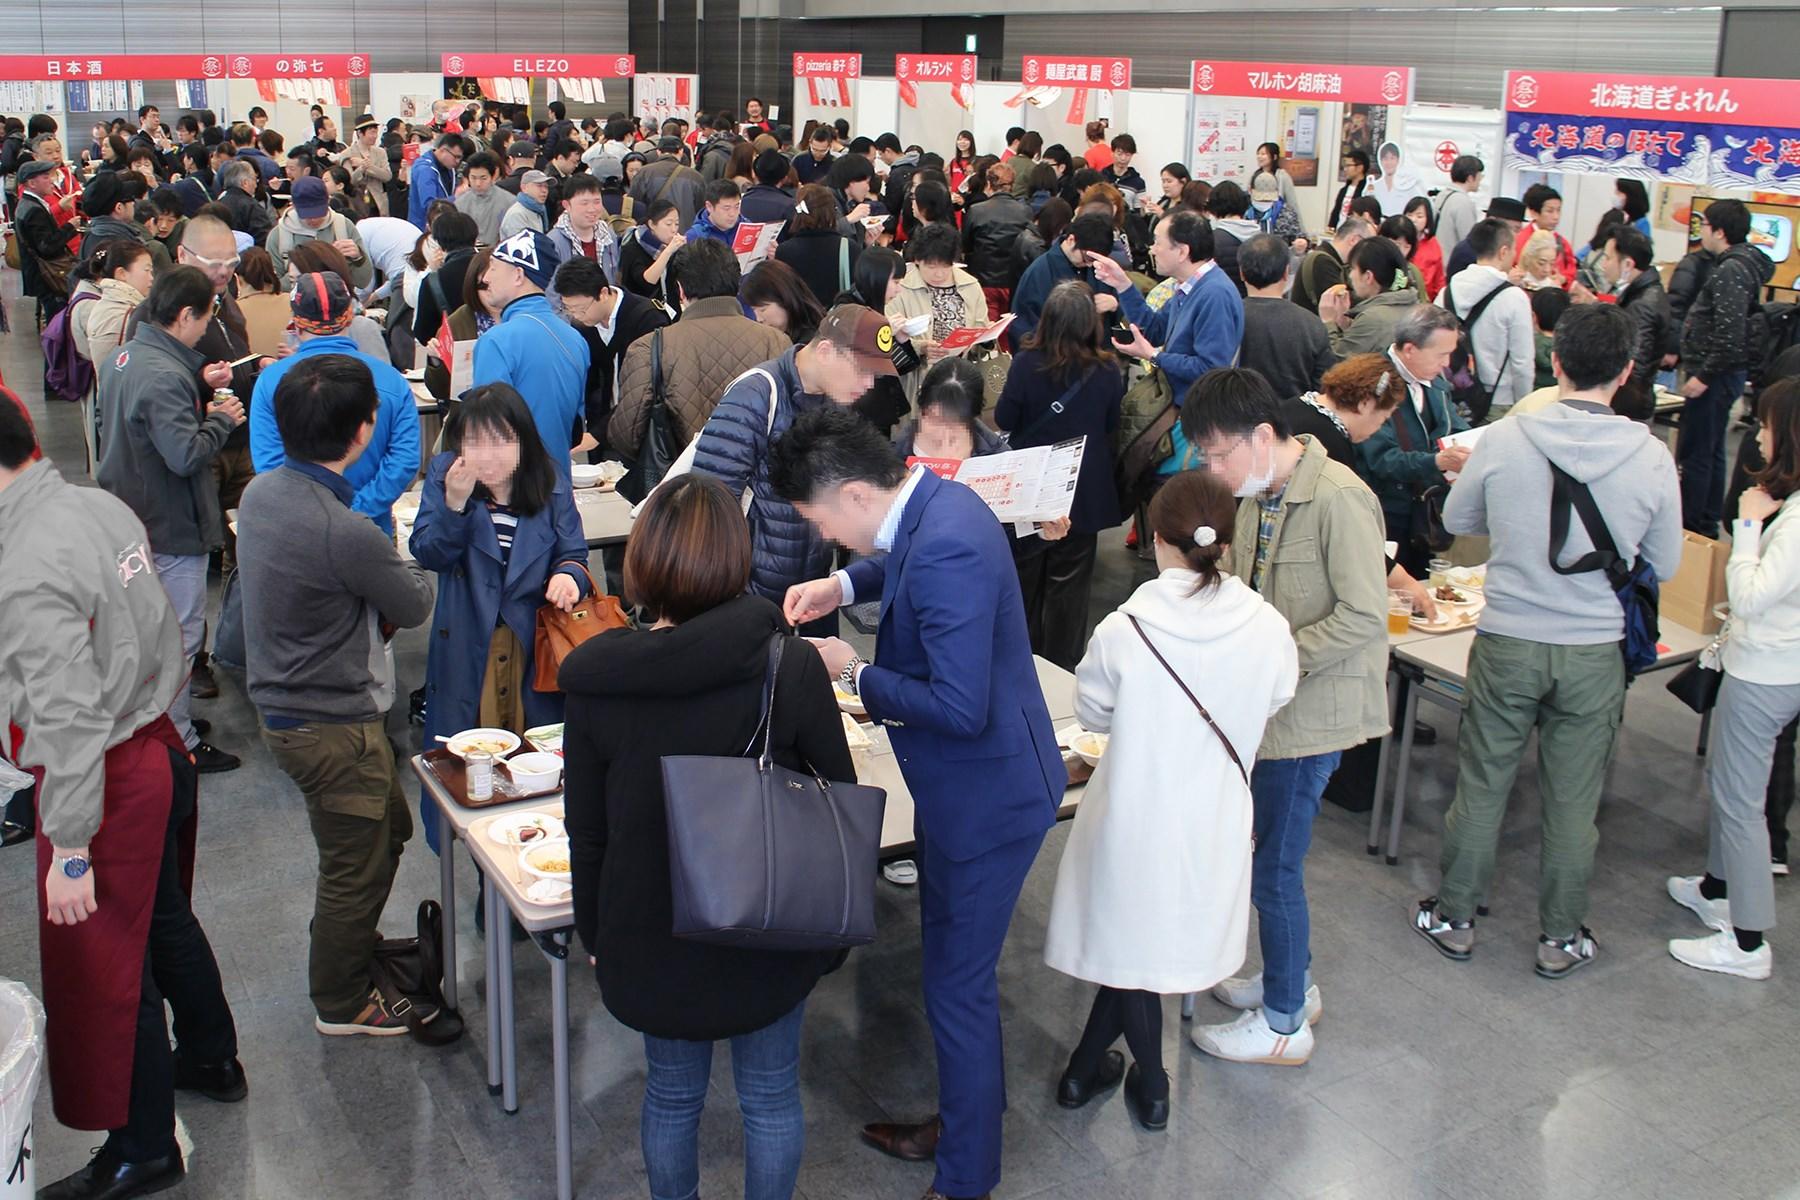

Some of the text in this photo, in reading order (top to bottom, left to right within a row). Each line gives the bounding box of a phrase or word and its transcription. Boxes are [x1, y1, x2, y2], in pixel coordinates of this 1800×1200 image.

[47, 60, 103, 75] 日本酒
[276, 59, 324, 73] の弥七
[513, 59, 569, 72] ELEZO
[916, 61, 953, 77] オルランド
[1247, 71, 1342, 95] マルホン胡麻油
[1589, 82, 1739, 113] 北海道ぎょれん
[1529, 123, 1685, 156] 北海道のほたて
